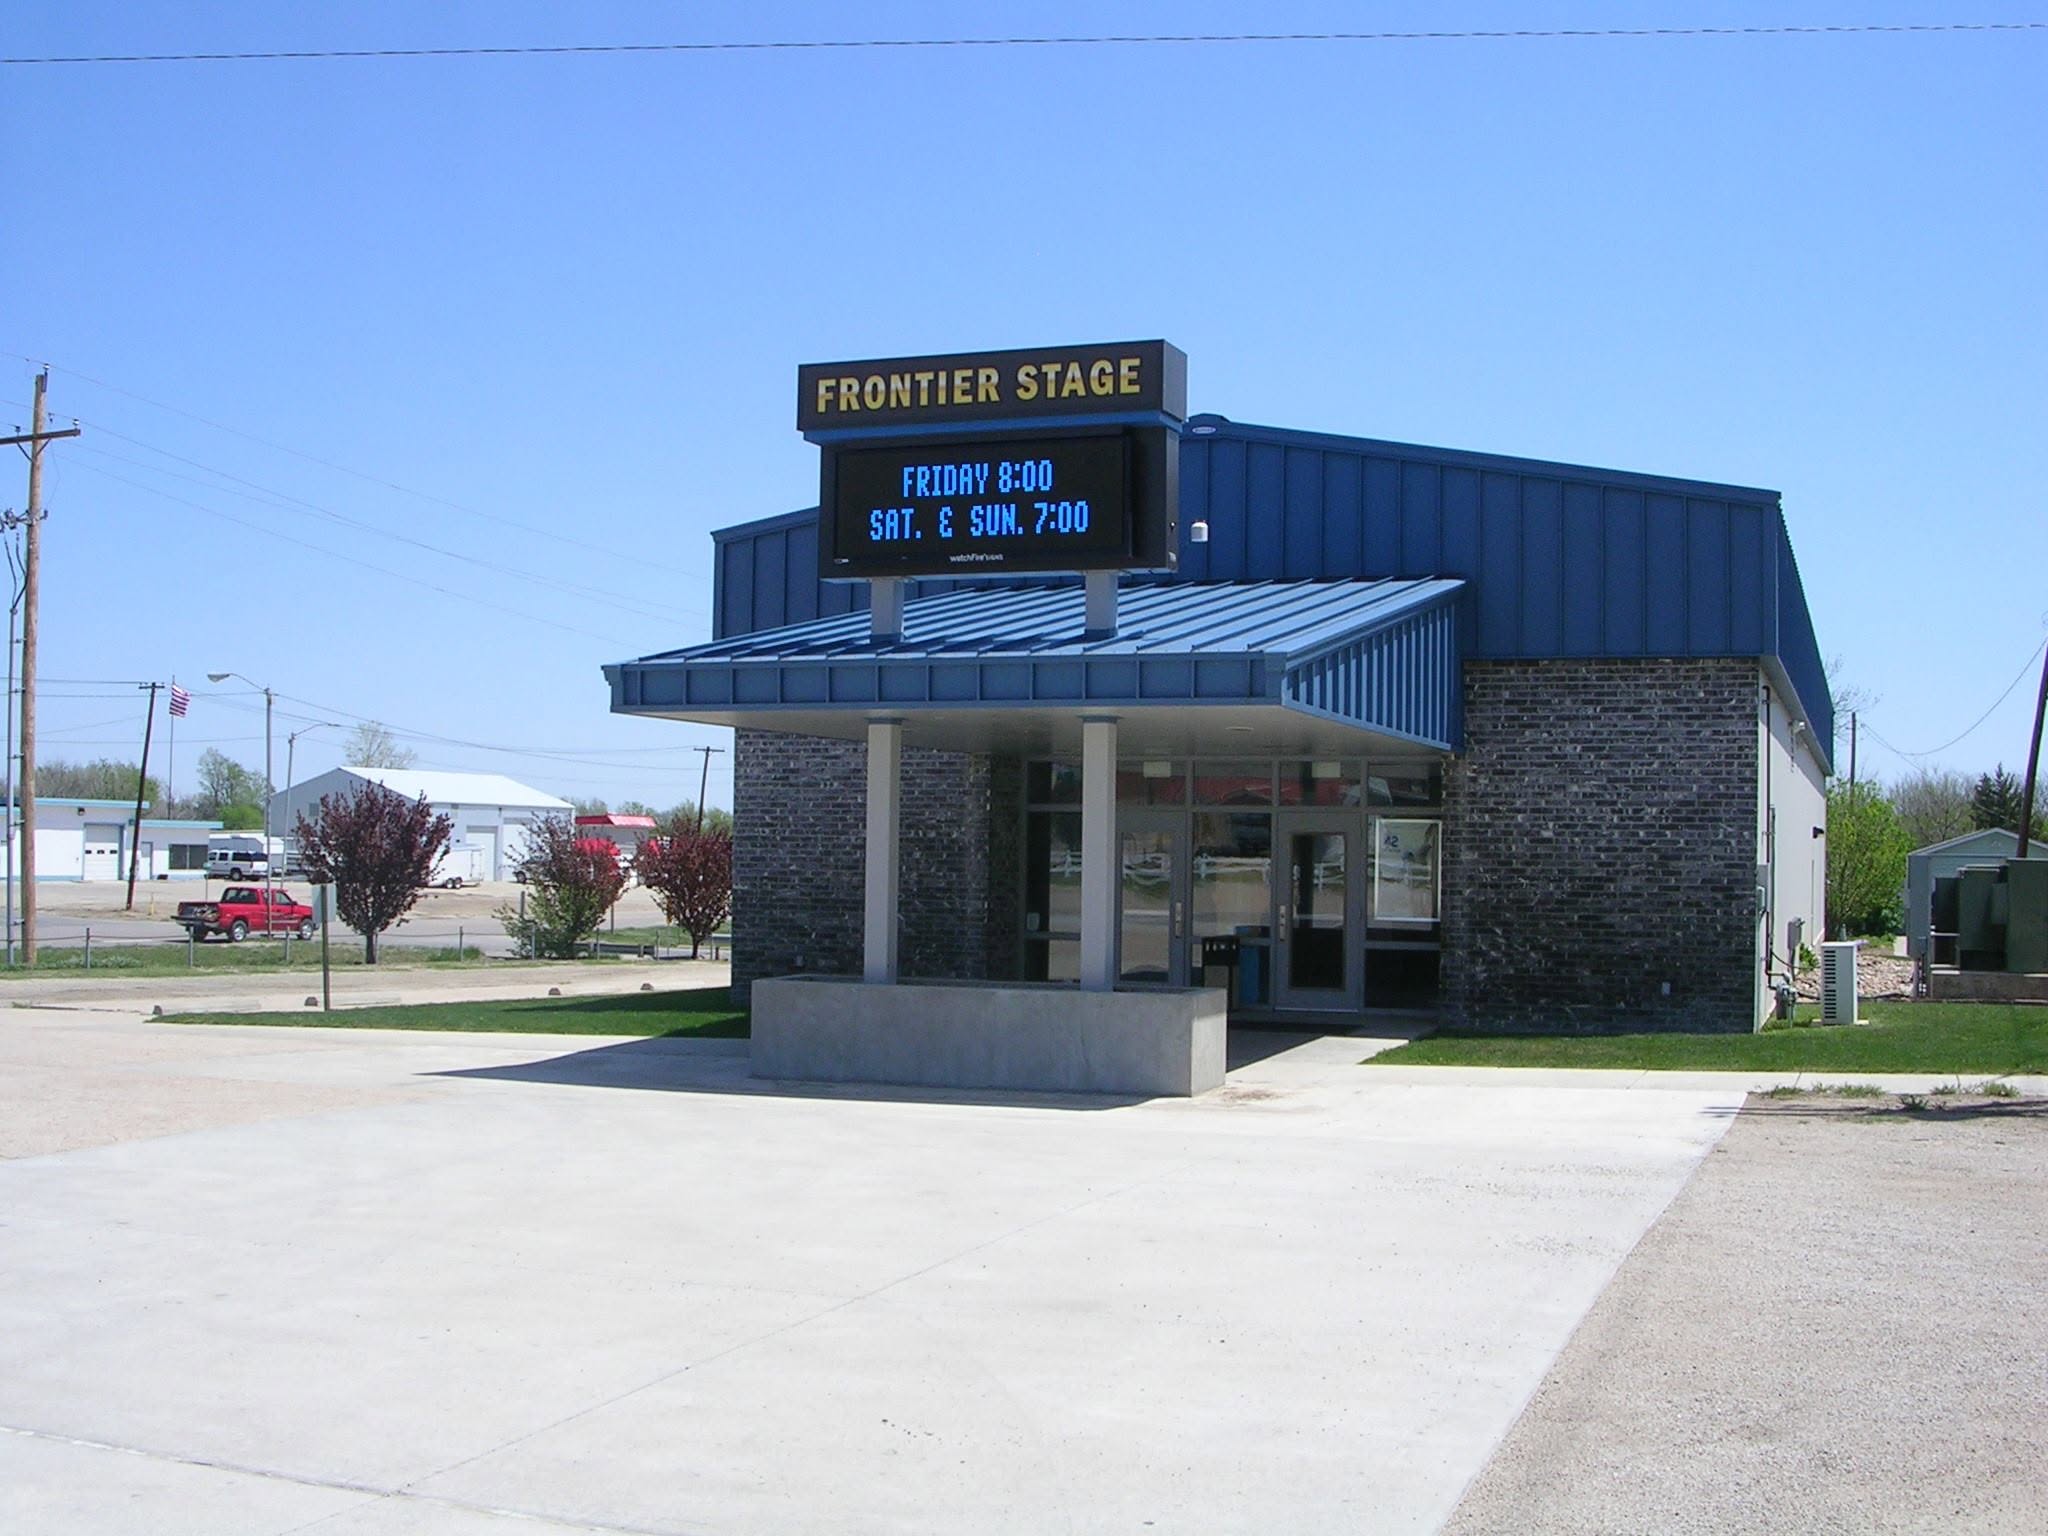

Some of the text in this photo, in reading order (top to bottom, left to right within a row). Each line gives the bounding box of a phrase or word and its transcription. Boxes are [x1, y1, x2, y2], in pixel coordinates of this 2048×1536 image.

[816, 358, 1141, 413] FRONTIER STAGE
[903, 459, 1053, 498] FRIDAY 8:00
[869, 500, 1089, 541] SAT. & SUN. 7:00
